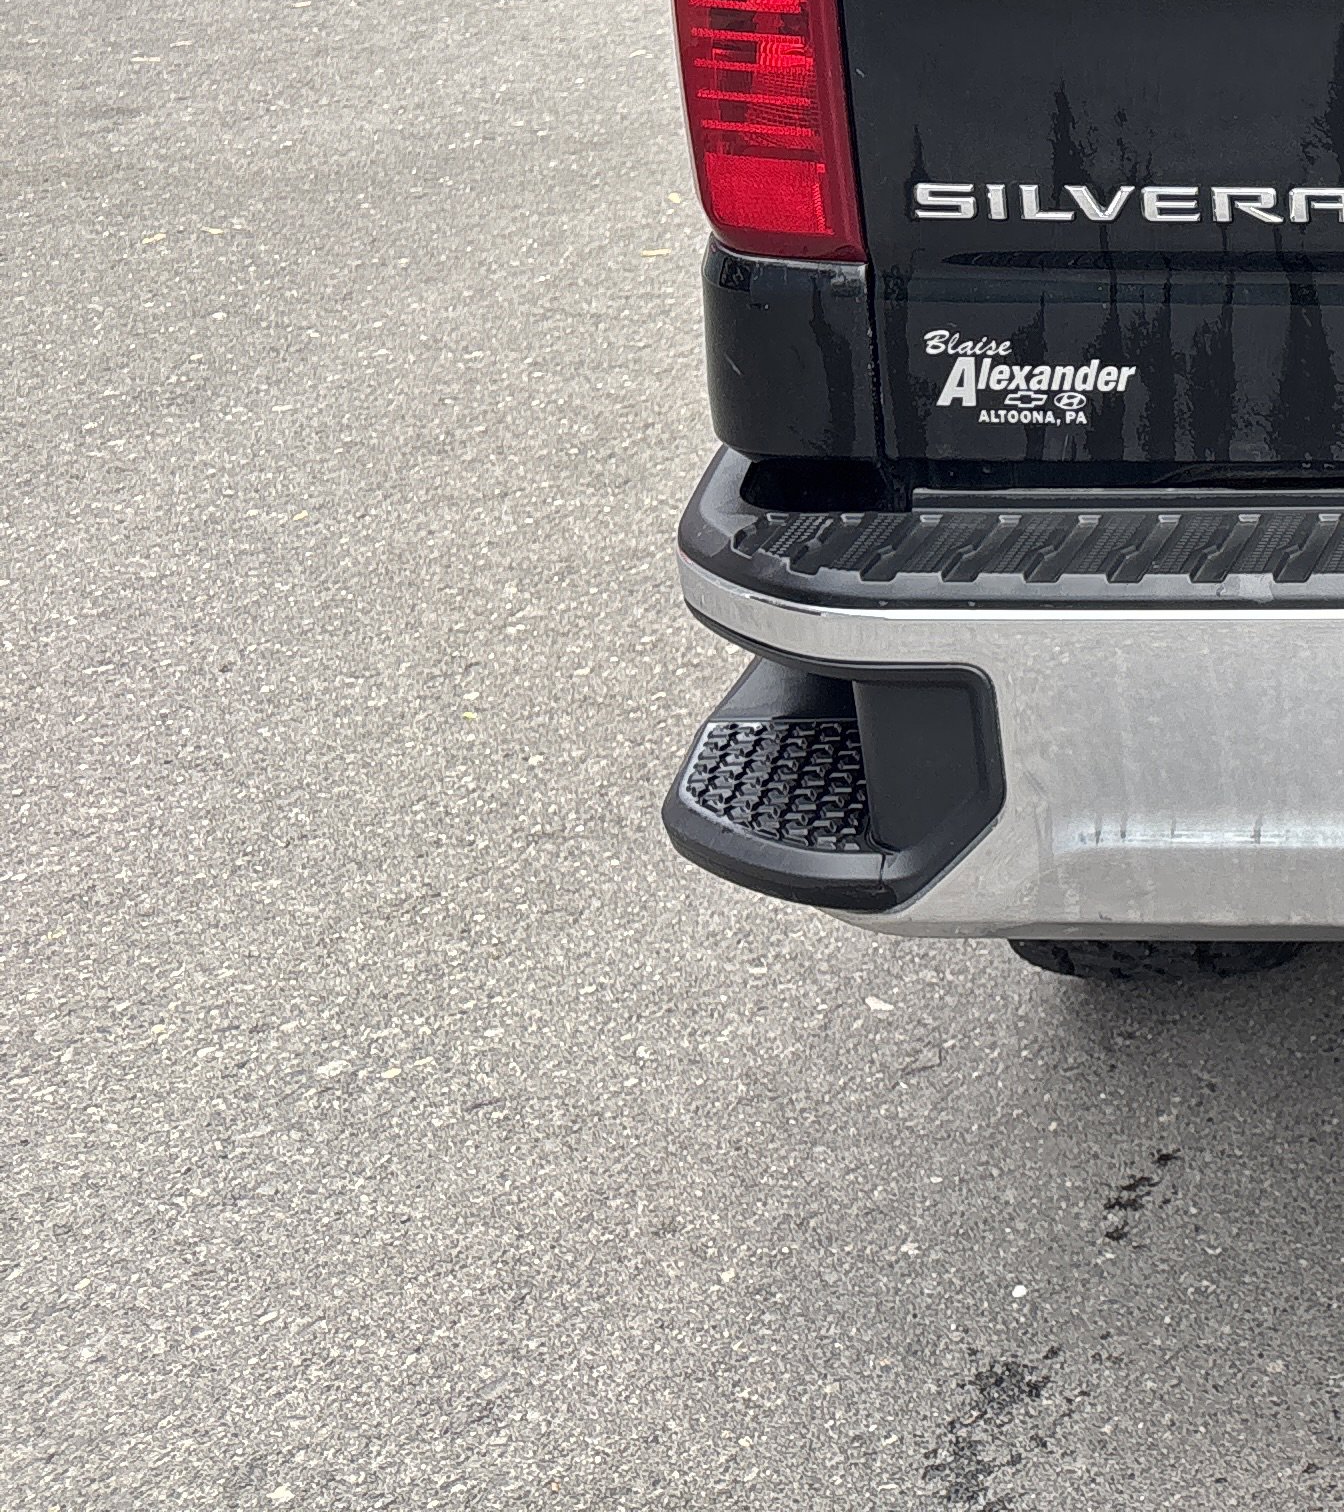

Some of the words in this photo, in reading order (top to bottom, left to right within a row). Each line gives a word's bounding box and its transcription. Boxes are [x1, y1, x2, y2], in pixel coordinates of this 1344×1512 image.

[923, 329, 1012, 356] Blaise
[935, 356, 1137, 407] Alexander
[978, 409, 1061, 426] ALTOONA,
[1065, 410, 1088, 425] PA
